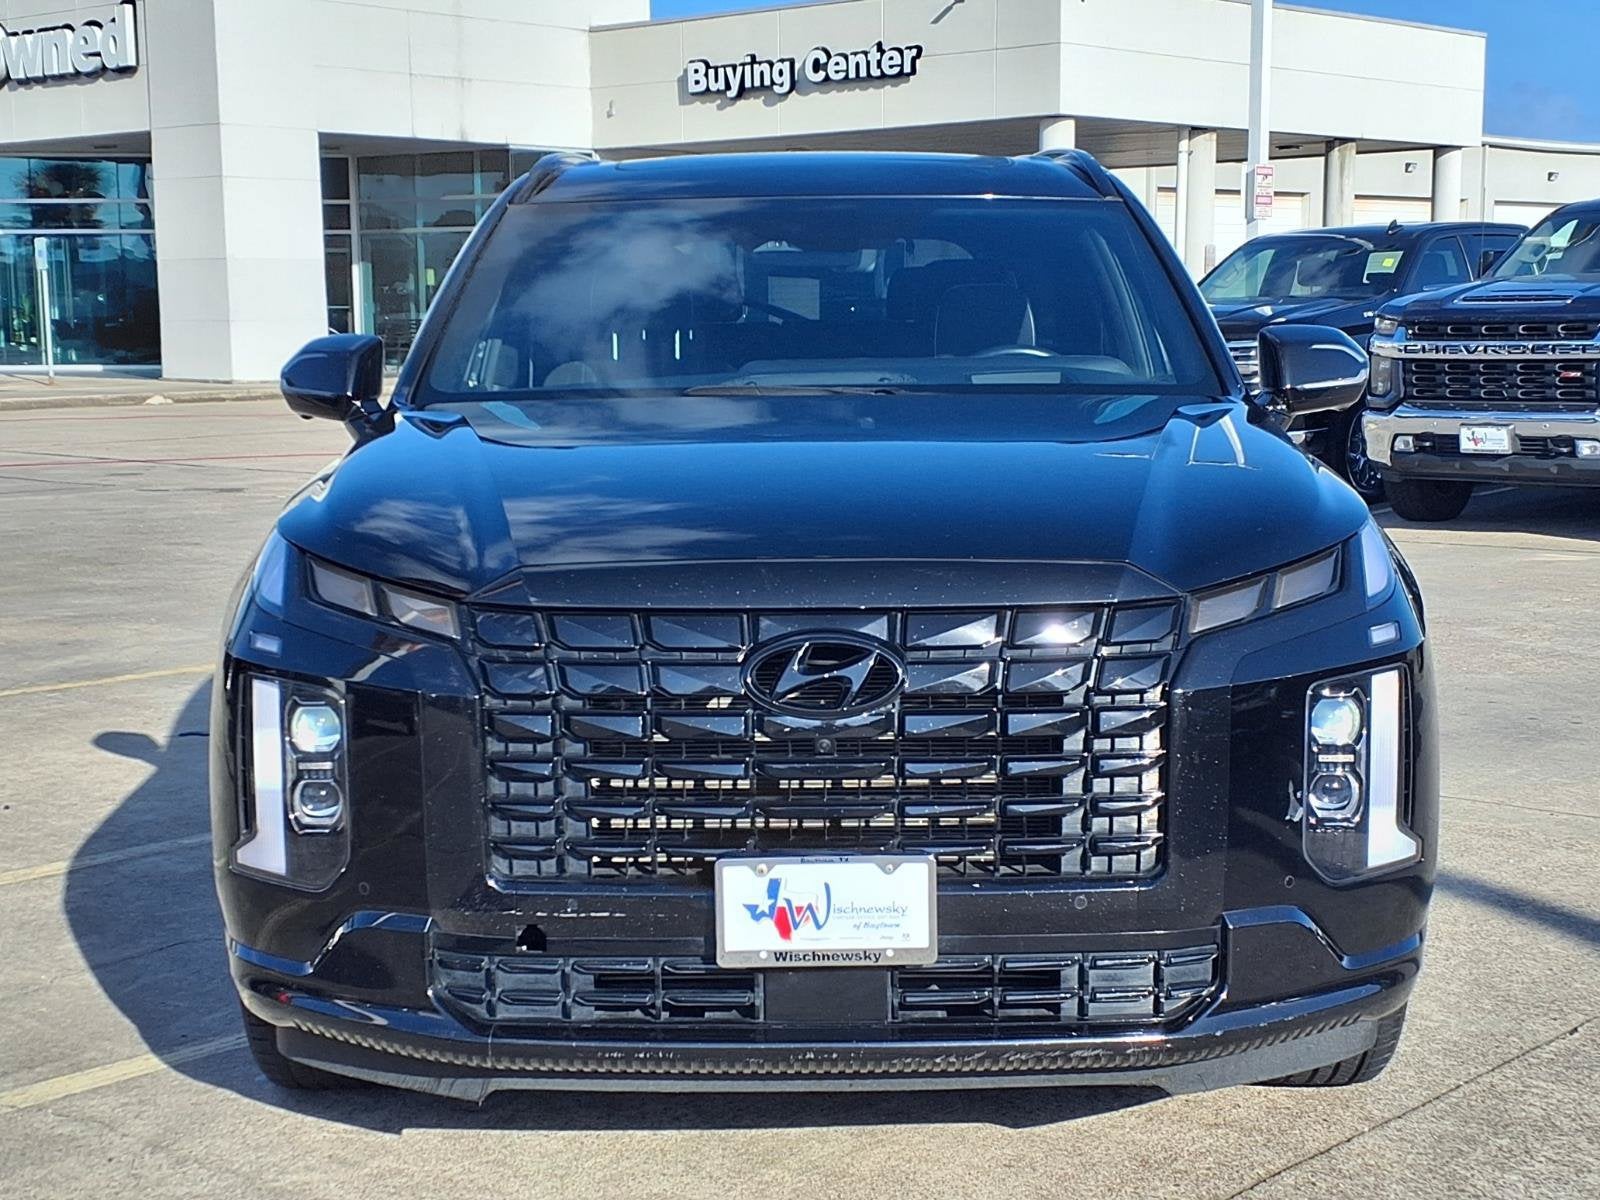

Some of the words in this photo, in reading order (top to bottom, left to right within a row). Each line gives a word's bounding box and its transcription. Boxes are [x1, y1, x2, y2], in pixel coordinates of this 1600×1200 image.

[0, 2, 138, 82] wned
[687, 54, 793, 98] Buying
[804, 42, 922, 83] Center
[774, 950, 881, 963] Wischnewsky
